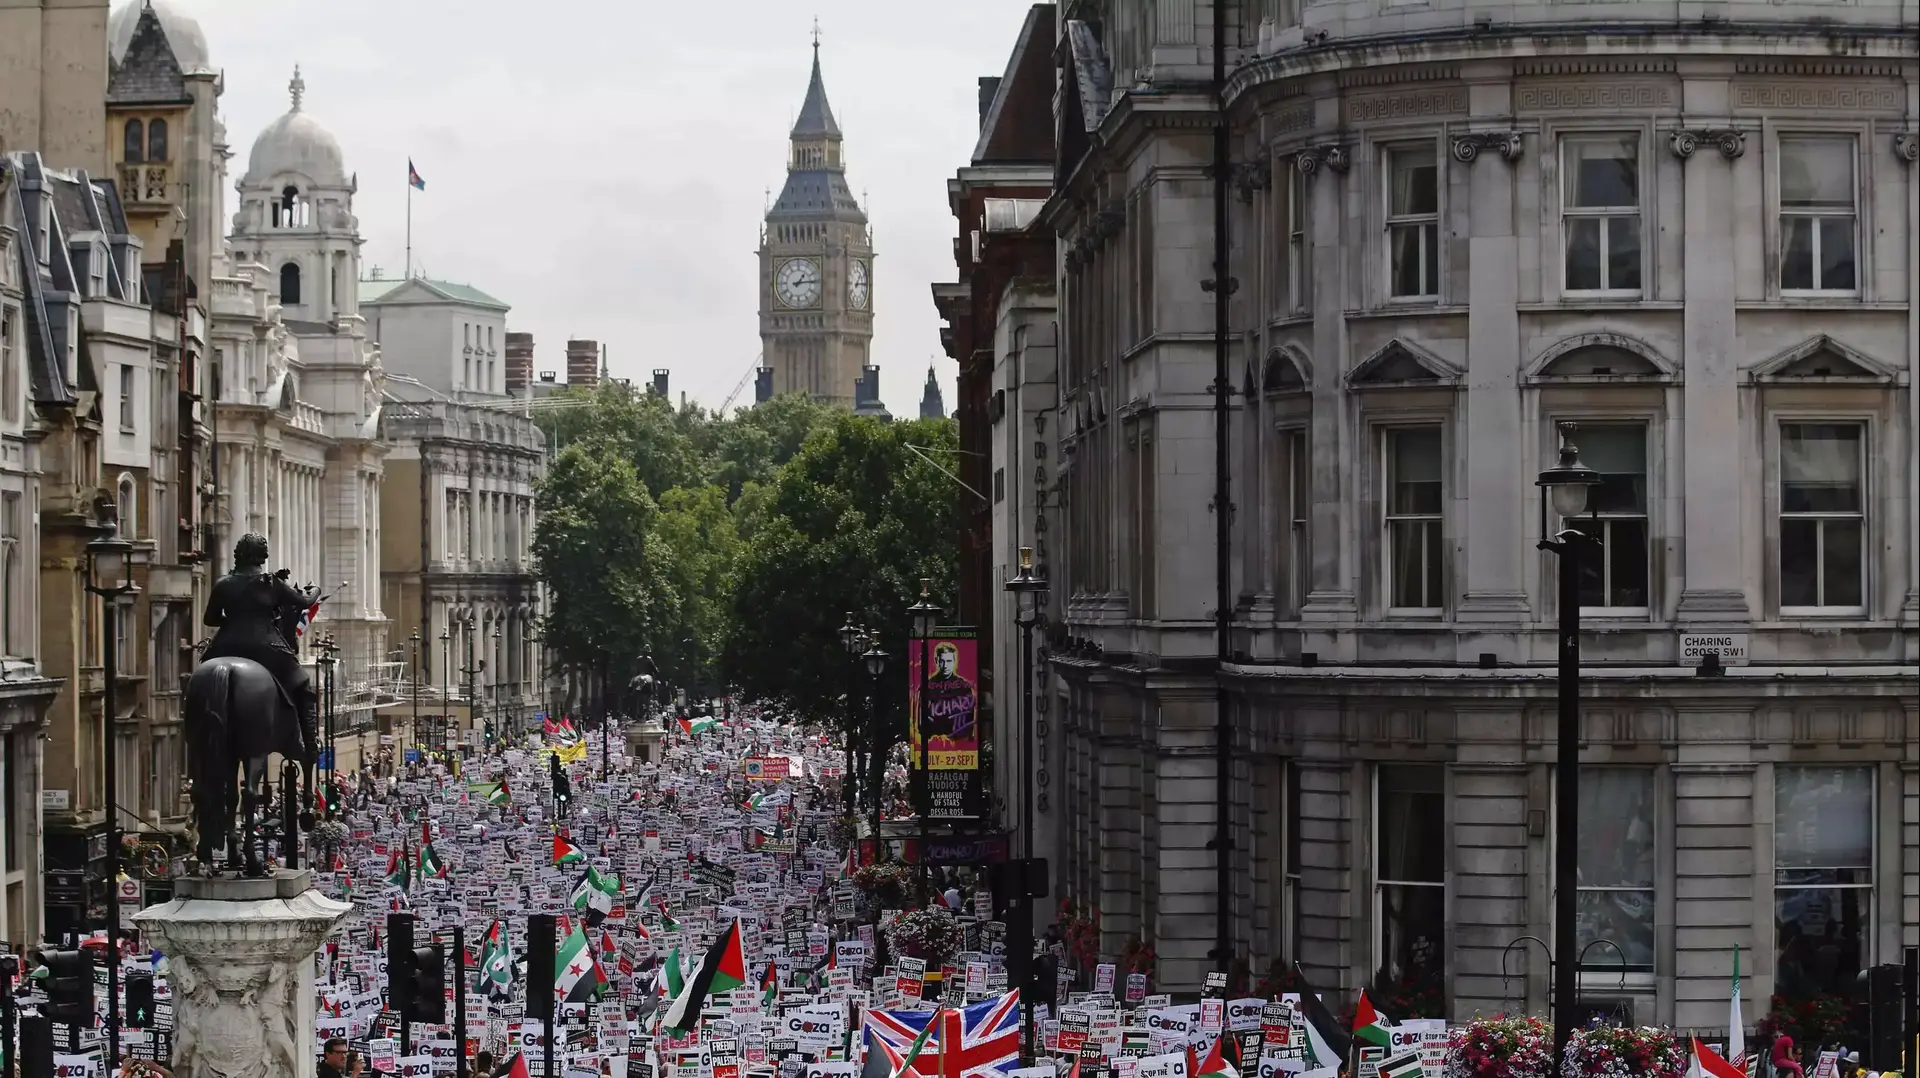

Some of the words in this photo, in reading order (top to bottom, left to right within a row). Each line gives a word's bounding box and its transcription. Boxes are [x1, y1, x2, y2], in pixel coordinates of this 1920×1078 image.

[1684, 637, 1732, 646] CHARING
[1684, 647, 1720, 657] CROSS
[1723, 647, 1744, 656] SW1
[928, 694, 974, 717] ICHARD
[1036, 647, 1049, 813] STUDIOS
[946, 756, 956, 765] 27
[957, 754, 975, 766] SEPT
[928, 772, 969, 781] RAFALGAR
[962, 781, 968, 790] 2
[936, 791, 963, 800] HANDFUL
[943, 799, 960, 807] STARS
[930, 808, 948, 816] DESSA
[949, 808, 964, 816] ROSE
[426, 881, 444, 889] Gza
[465, 889, 488, 897] Gza
[541, 902, 564, 910] Gza
[788, 931, 802, 939] END
[838, 946, 862, 955] Gza
[902, 961, 923, 970] FREEDOM
[900, 971, 923, 980] PALESTINE
[1208, 972, 1219, 980] STOP
[155, 1004, 172, 1014] END
[1263, 1006, 1289, 1016] FREEDOM
[1062, 1013, 1088, 1023] FREEDOM
[1261, 1018, 1289, 1027] PALESTINE
[789, 1018, 829, 1033] Gza
[1148, 1014, 1186, 1032] Gza
[1060, 1024, 1088, 1033] PALESTINE
[1245, 1035, 1260, 1046] END
[1392, 1032, 1421, 1046] Gz
[419, 1044, 456, 1057] Gza
[629, 1046, 646, 1054] STOP
[771, 1042, 796, 1050] FREEDOM
[1081, 1050, 1100, 1058] STOP
[1274, 1050, 1291, 1059] STOP
[1291, 1048, 1303, 1057] THE
[54, 1063, 85, 1077] za
